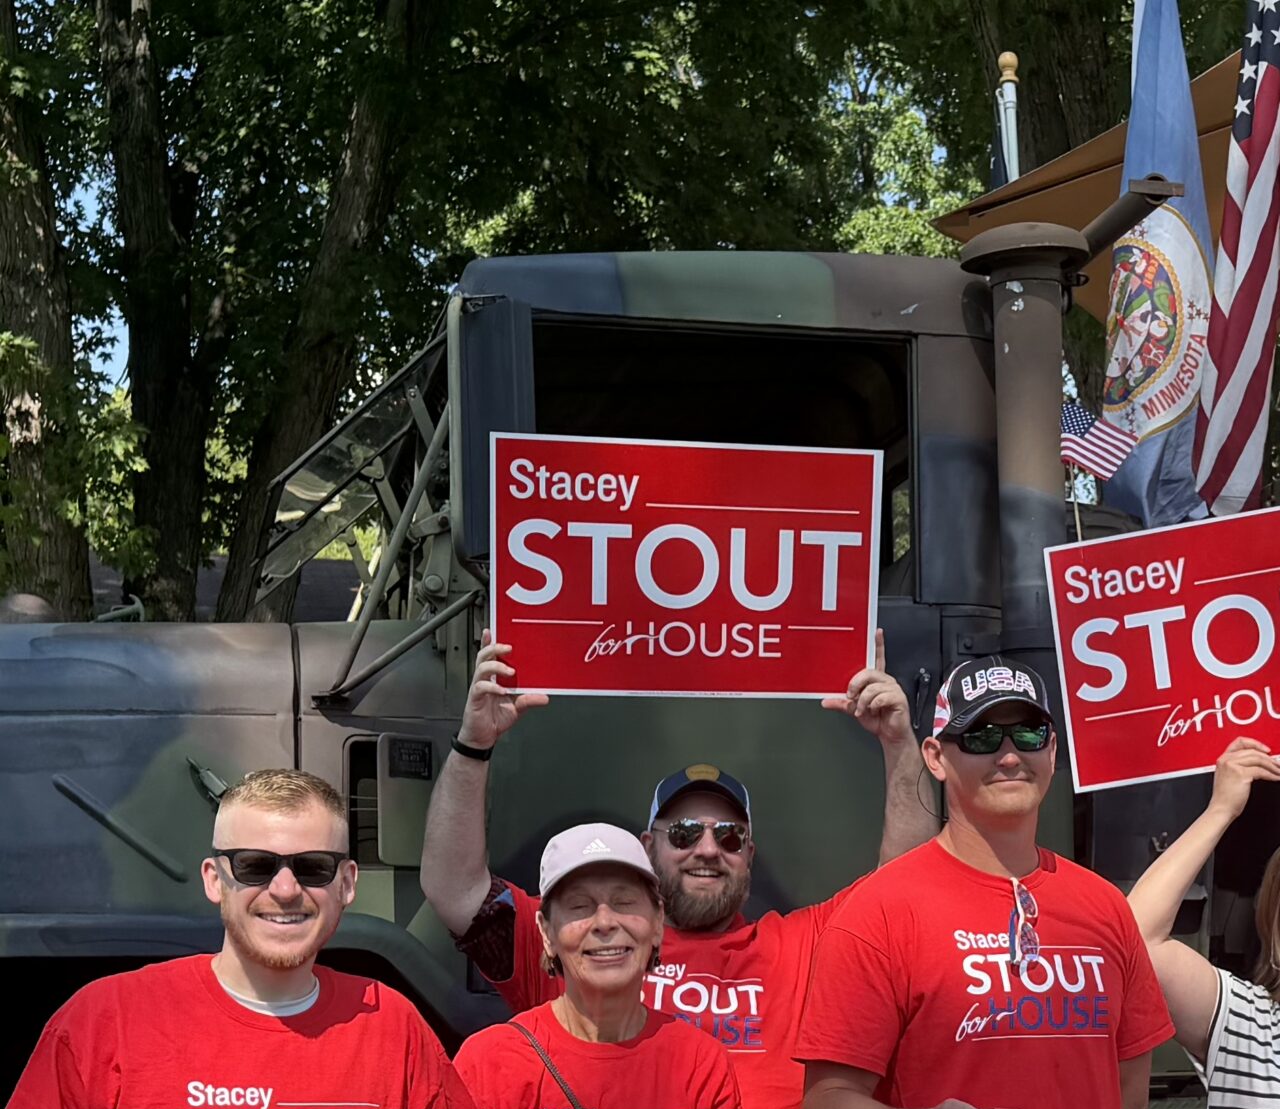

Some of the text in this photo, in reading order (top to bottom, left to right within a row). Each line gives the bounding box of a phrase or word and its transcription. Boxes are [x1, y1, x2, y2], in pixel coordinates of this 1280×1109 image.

[1141, 333, 1206, 420] MINNESOTA
[509, 458, 640, 511] Stacey
[505, 518, 862, 611] STOUT
[1064, 557, 1186, 605] Stacey
[584, 621, 782, 662] for HOUSE
[961, 667, 1036, 700] USA
[1157, 705, 1200, 747] for
[954, 930, 1010, 950] Stace
[640, 975, 764, 1015] TOUT
[962, 954, 1104, 995] STOUT
[956, 996, 1109, 1042] for HOUSE
